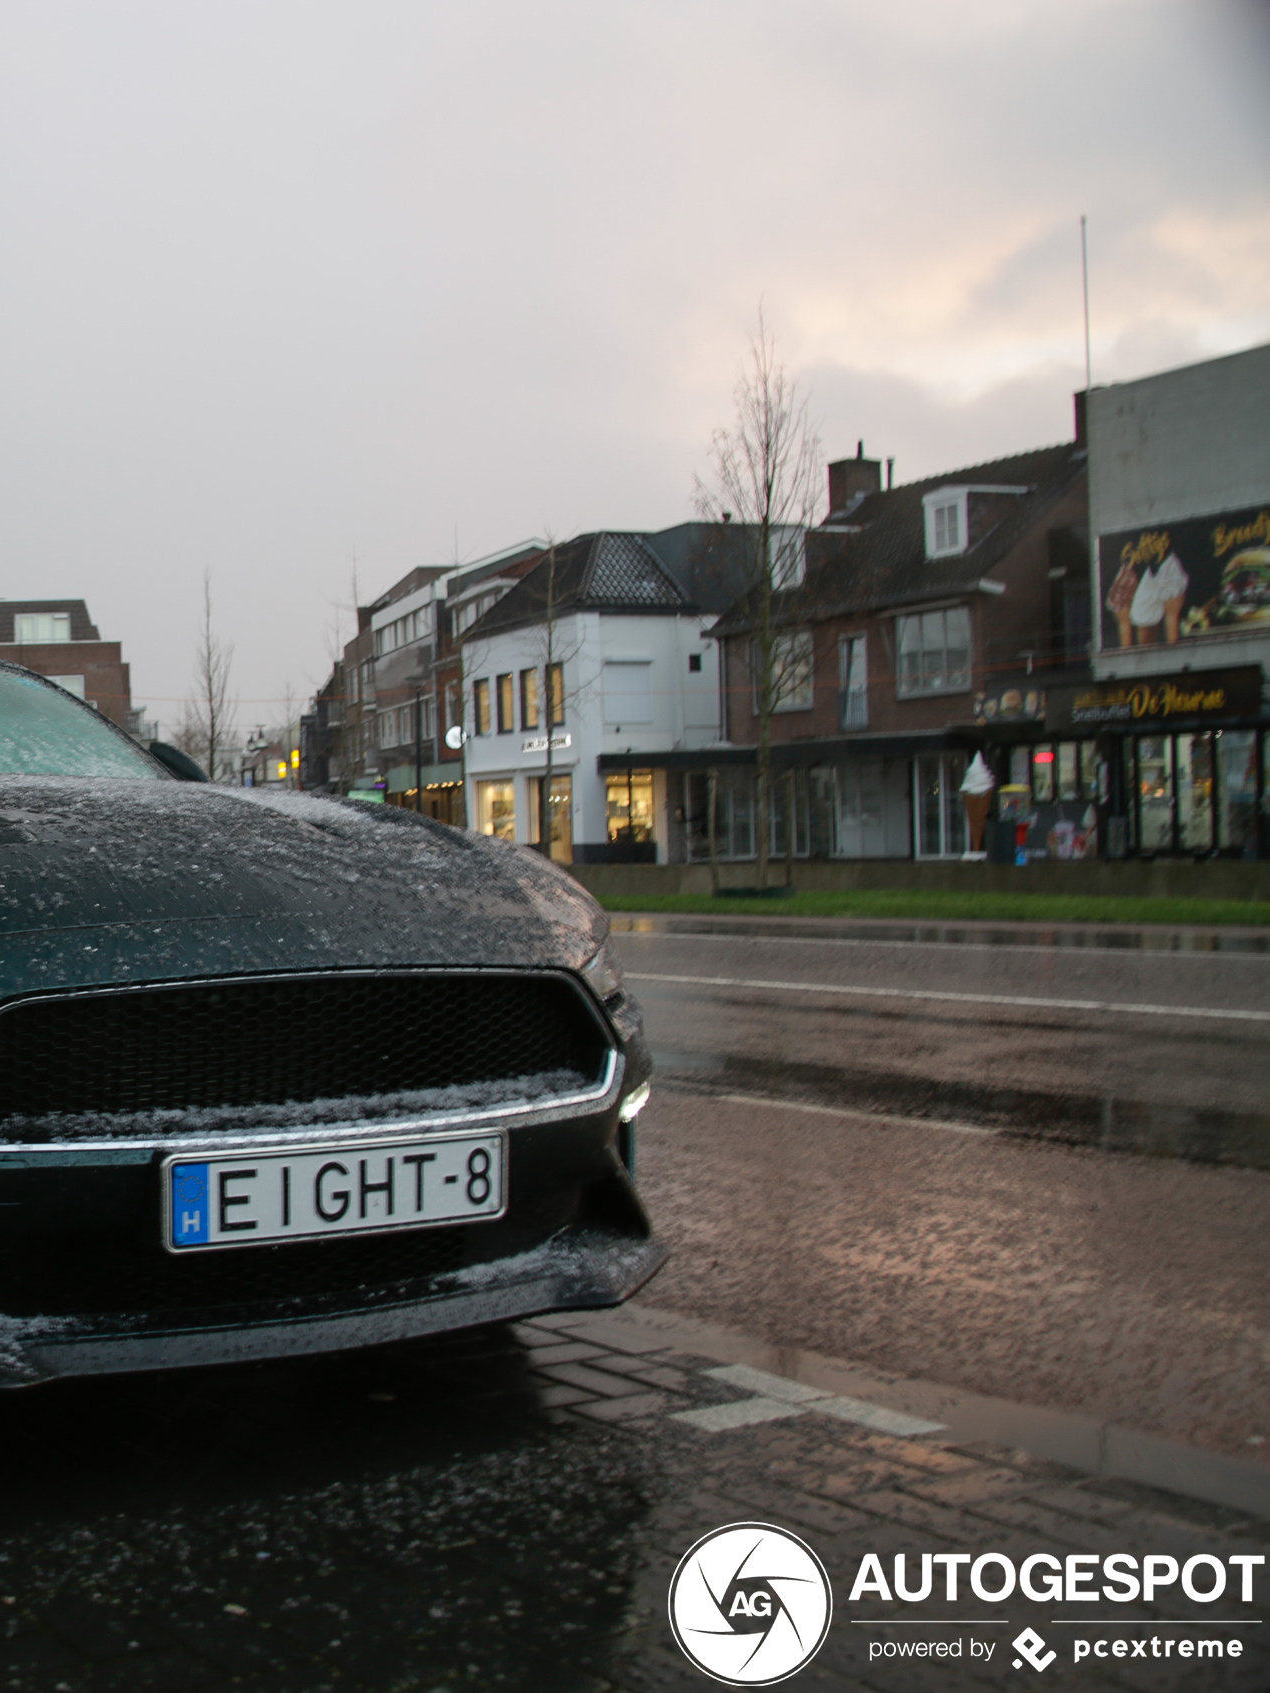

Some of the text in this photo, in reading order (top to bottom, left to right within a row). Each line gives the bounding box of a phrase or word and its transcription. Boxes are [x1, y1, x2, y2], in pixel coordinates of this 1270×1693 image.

[1127, 685, 1160, 718] De
[218, 1147, 492, 1233] EIGHT-8
[181, 1209, 201, 1235] H
